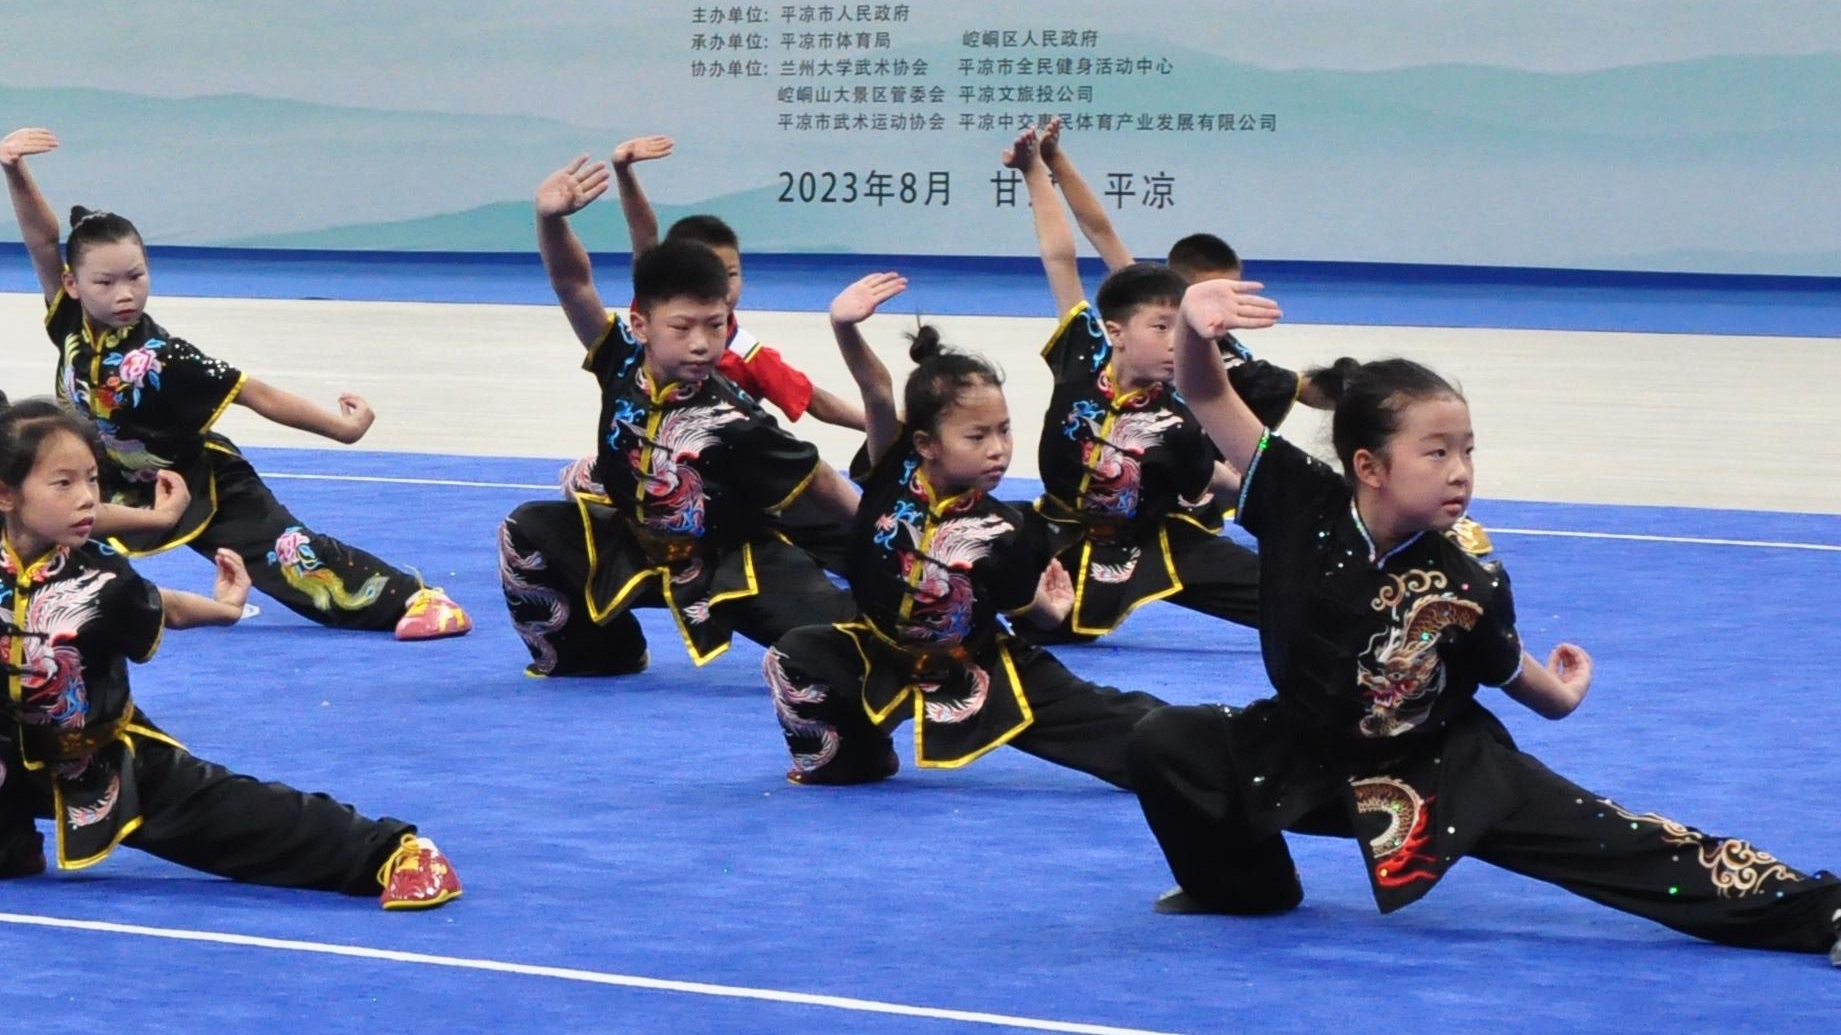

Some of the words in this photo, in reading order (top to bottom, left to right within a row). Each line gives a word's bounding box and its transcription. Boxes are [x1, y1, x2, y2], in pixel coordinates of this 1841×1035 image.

[780, 4, 910, 23] 平凉市人民政府
[780, 31, 892, 50] 平凉市体育局
[962, 29, 1099, 48] 崆峒区人民政府
[780, 58, 929, 76] 兰州大学武术协会
[958, 56, 1174, 76] 平凉市全民健身活动中心
[777, 85, 946, 104] 崆峒山大景区管委会
[959, 84, 1094, 104] 平凉文旅投公司
[777, 112, 945, 131] 平凉市武术运动协会
[778, 170, 951, 206] 2023年8月
[1104, 170, 1176, 210] 平凉
